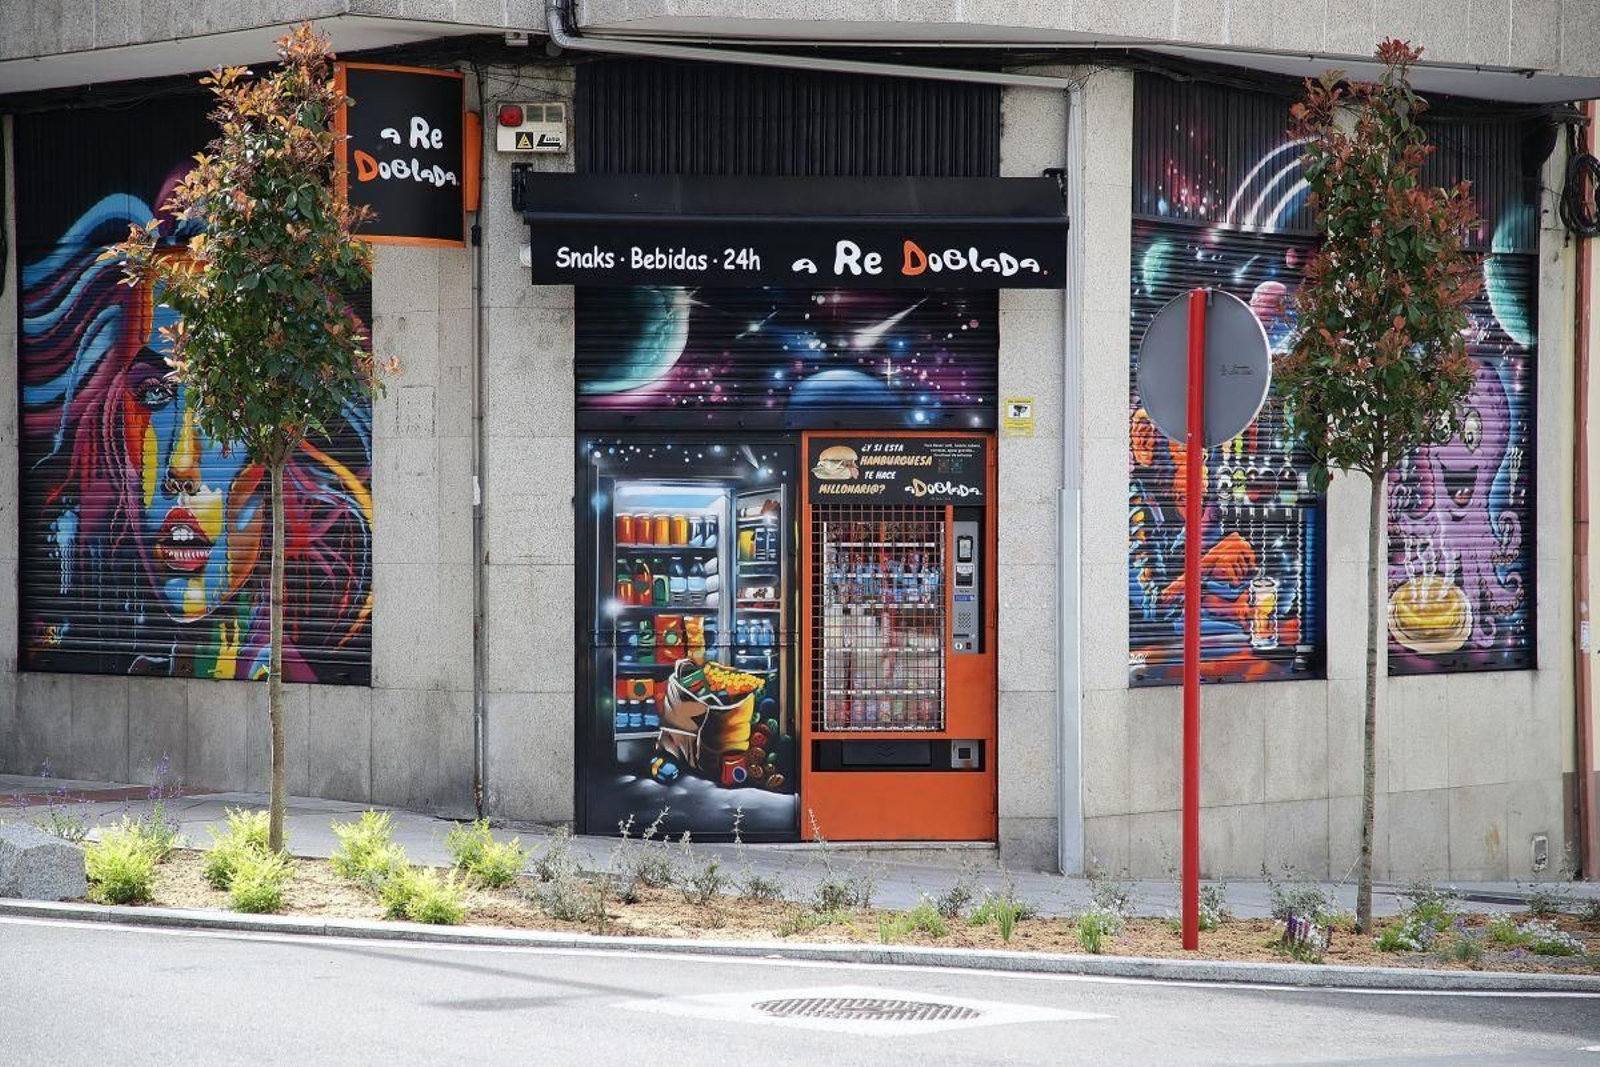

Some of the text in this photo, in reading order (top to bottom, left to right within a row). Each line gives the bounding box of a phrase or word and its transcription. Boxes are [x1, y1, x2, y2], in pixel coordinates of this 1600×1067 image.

[410, 116, 444, 149] Re
[555, 245, 760, 271] Snaks Bebidas 24h
[833, 240, 883, 275] Re
[873, 443, 883, 452] SI
[884, 443, 904, 452] ESTA
[860, 455, 933, 466] HAMBURGUESA
[864, 471, 896, 480] TE HACE
